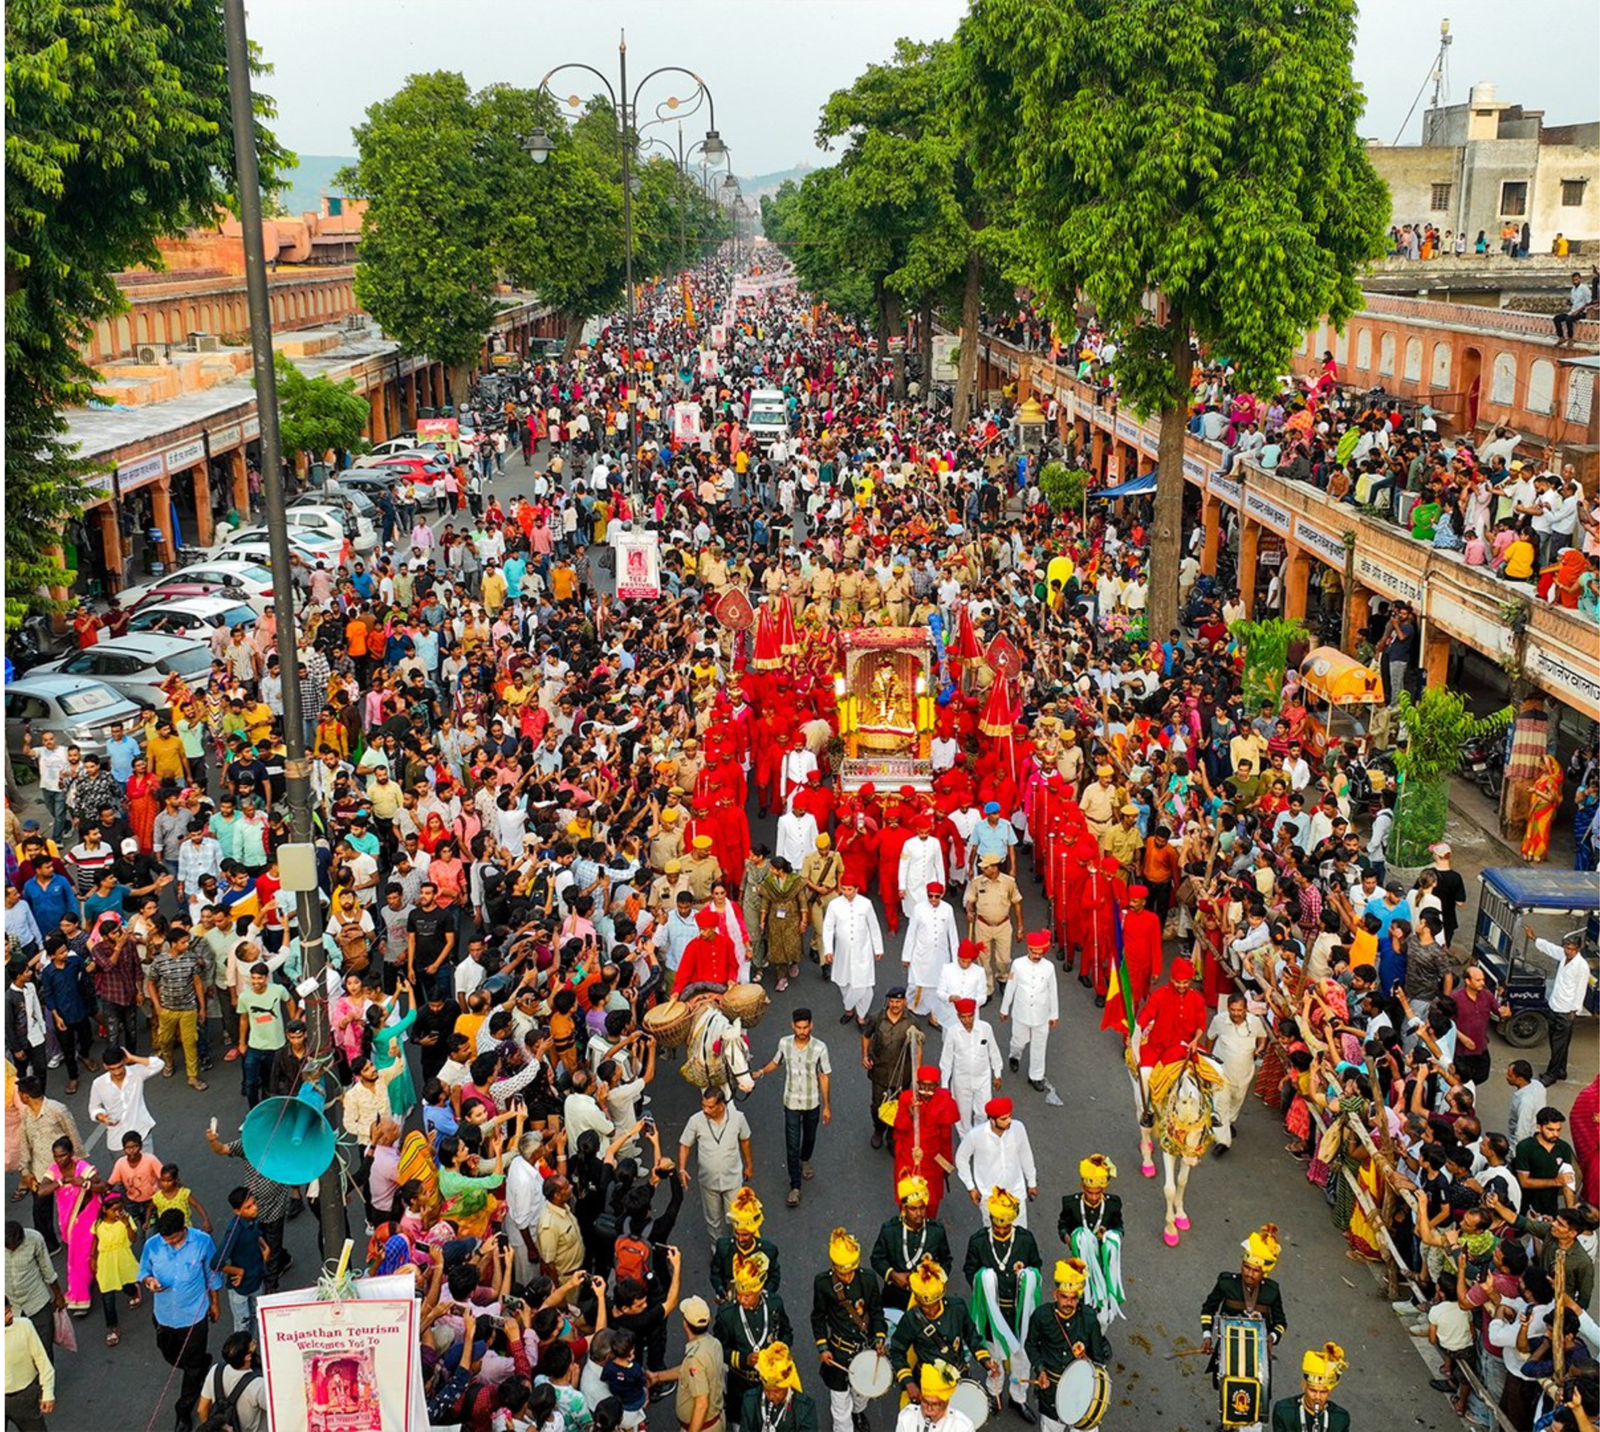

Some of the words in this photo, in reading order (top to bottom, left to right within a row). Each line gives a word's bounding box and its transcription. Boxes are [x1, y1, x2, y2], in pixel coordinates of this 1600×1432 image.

[276, 1328, 342, 1343] Rajasthan
[346, 1325, 400, 1337] Tourism
[297, 1340, 346, 1351] Welcomes
[367, 1336, 380, 1346] To
